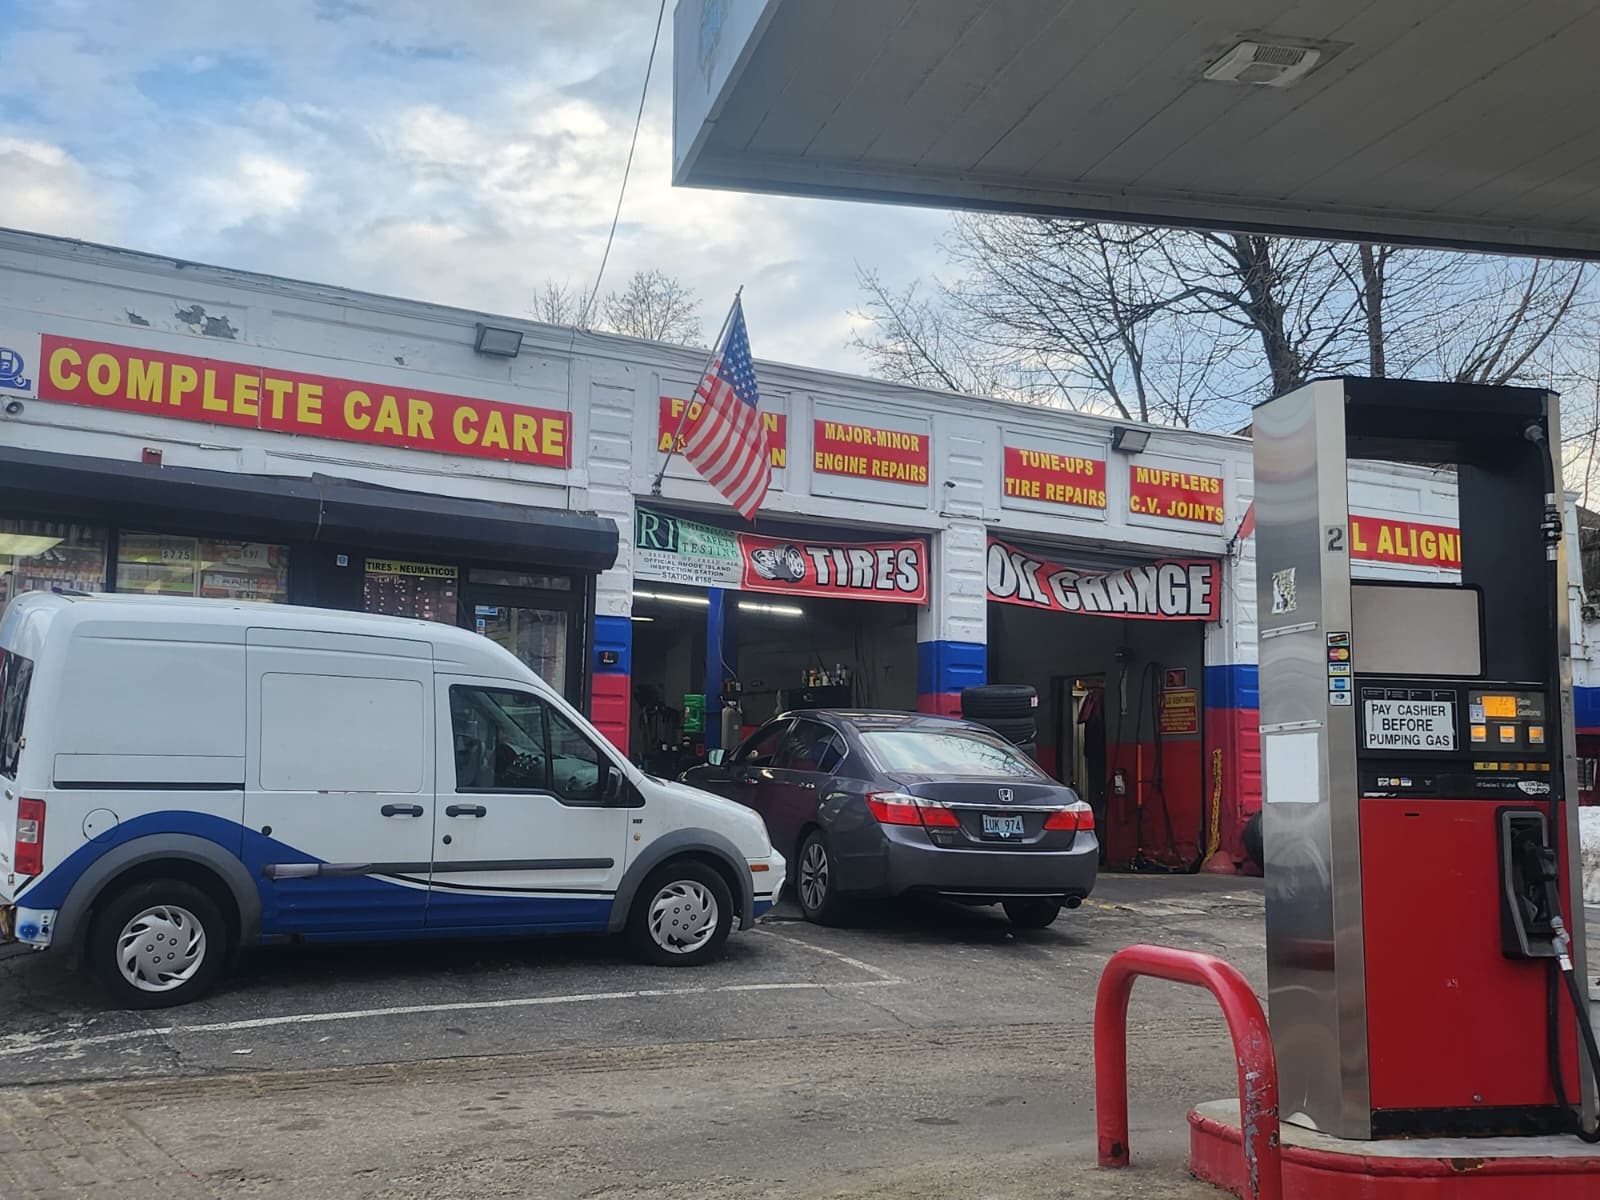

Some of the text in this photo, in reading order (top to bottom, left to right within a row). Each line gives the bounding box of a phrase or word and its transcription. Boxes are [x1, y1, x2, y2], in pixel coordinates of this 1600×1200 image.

[49, 348, 564, 456] COMPLETE CAR CARE
[825, 423, 919, 452] MAJOR-MINOR
[815, 452, 927, 482] ENGINE REPAIRS
[1020, 450, 1094, 475] TUNE-UPS
[1005, 478, 1106, 507] TIRE REPAIRS
[1136, 467, 1220, 494] MUFFLERS
[1130, 498, 1224, 524] C.V. JOINTS
[638, 512, 676, 550] RI
[1327, 527, 1344, 551] 2
[682, 542, 738, 558] TESTING
[367, 561, 392, 572] TIRES
[644, 557, 731, 572] OFFICIAL RHODE ISLAND
[650, 564, 724, 577] INSPECTION STATION
[662, 572, 693, 581] STATION
[807, 546, 919, 592] TIRES
[987, 543, 1213, 615] OIL CHANGE
[1372, 704, 1446, 716] PAY CASHIER
[1382, 718, 1434, 731] BEFORE
[1370, 734, 1449, 746] PUMPING GAS
[1004, 819, 1021, 832] 974
